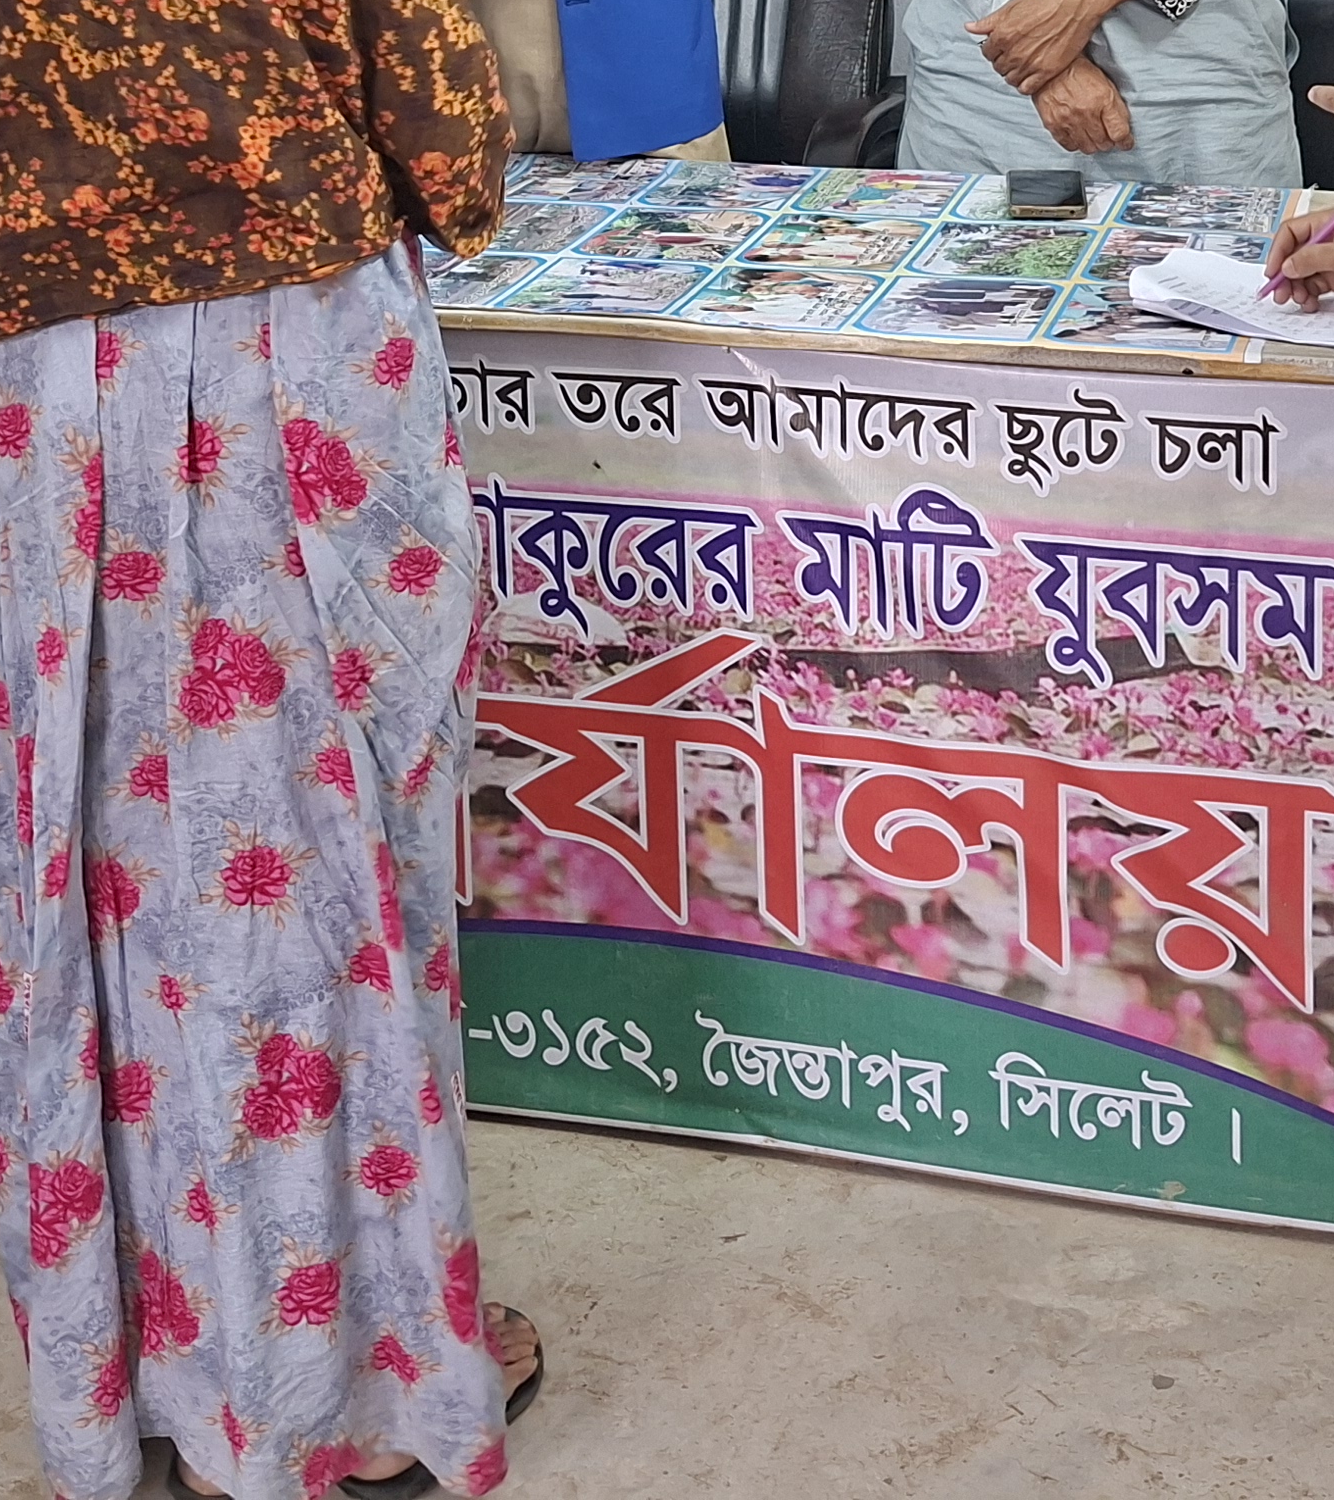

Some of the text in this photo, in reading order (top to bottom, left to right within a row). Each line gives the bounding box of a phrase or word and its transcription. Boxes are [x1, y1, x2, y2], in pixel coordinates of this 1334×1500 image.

[551, 371, 682, 437] তরে
[698, 375, 976, 460] আমাদের
[995, 388, 1125, 488] ছুটে
[1145, 414, 1280, 486] চলা
[473, 479, 758, 638] াকুরের
[783, 489, 993, 633] মাটি
[465, 1008, 678, 1094] -৩১৫২,
[695, 1009, 970, 1136] জৈন্তাপুর,
[987, 1051, 1194, 1150] সিলেট
